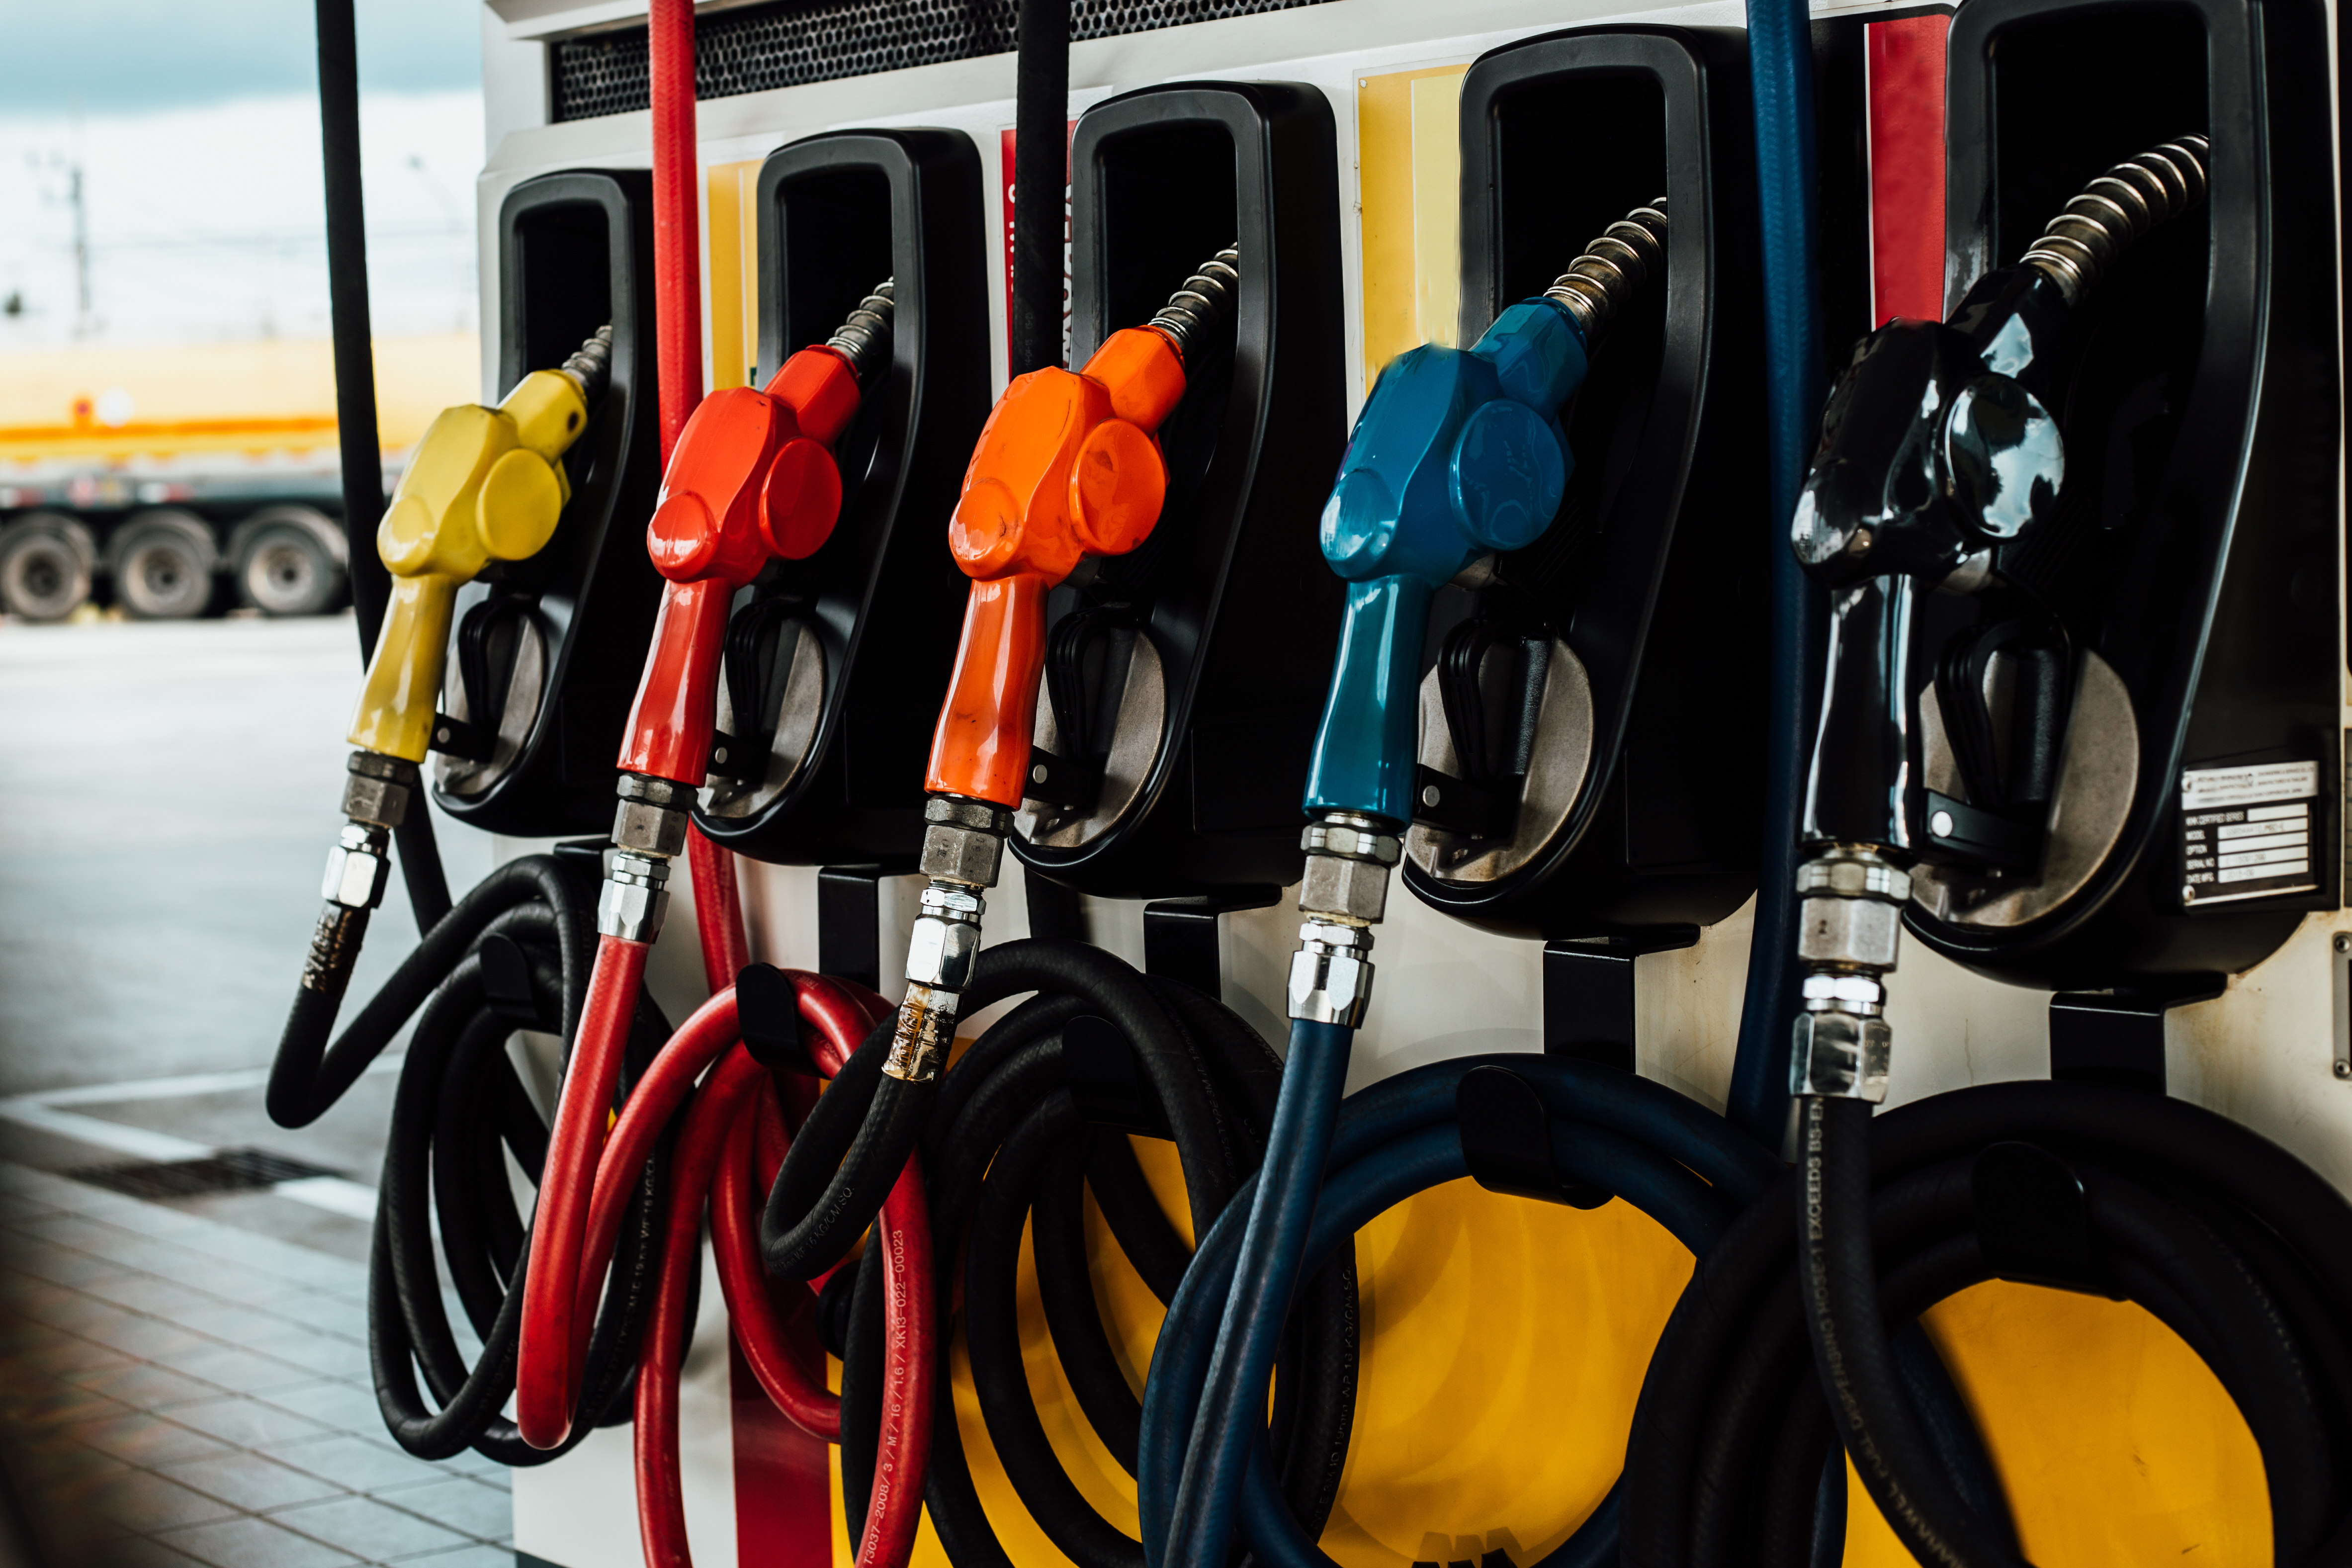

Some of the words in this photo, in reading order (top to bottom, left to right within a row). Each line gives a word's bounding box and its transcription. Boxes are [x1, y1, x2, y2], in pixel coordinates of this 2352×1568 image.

[2185, 844, 2207, 856] OPTION
[1197, 1063, 1208, 1078] ID
[1210, 1100, 1225, 1133] TYPE
[795, 1246, 806, 1261] WP
[805, 1237, 817, 1250] 16
[814, 1186, 855, 1239] KG/CM.SQ.
[893, 1229, 907, 1349] XK13-022-00023
[1342, 1266, 1354, 1348] KG/CM.SQ.
[1807, 1156, 1824, 1240] EXCEEDS
[1860, 1431, 1889, 1479] FUEL
[1344, 1353, 1353, 1369] 16
[893, 1366, 904, 1385] 1.6
[1342, 1375, 1351, 1398] WP
[891, 1403, 901, 1418] 16
[1335, 1404, 1348, 1446] 19mm
[887, 1435, 898, 1447] M
[883, 1463, 893, 1473] 3
[1329, 1452, 1340, 1466] ID
